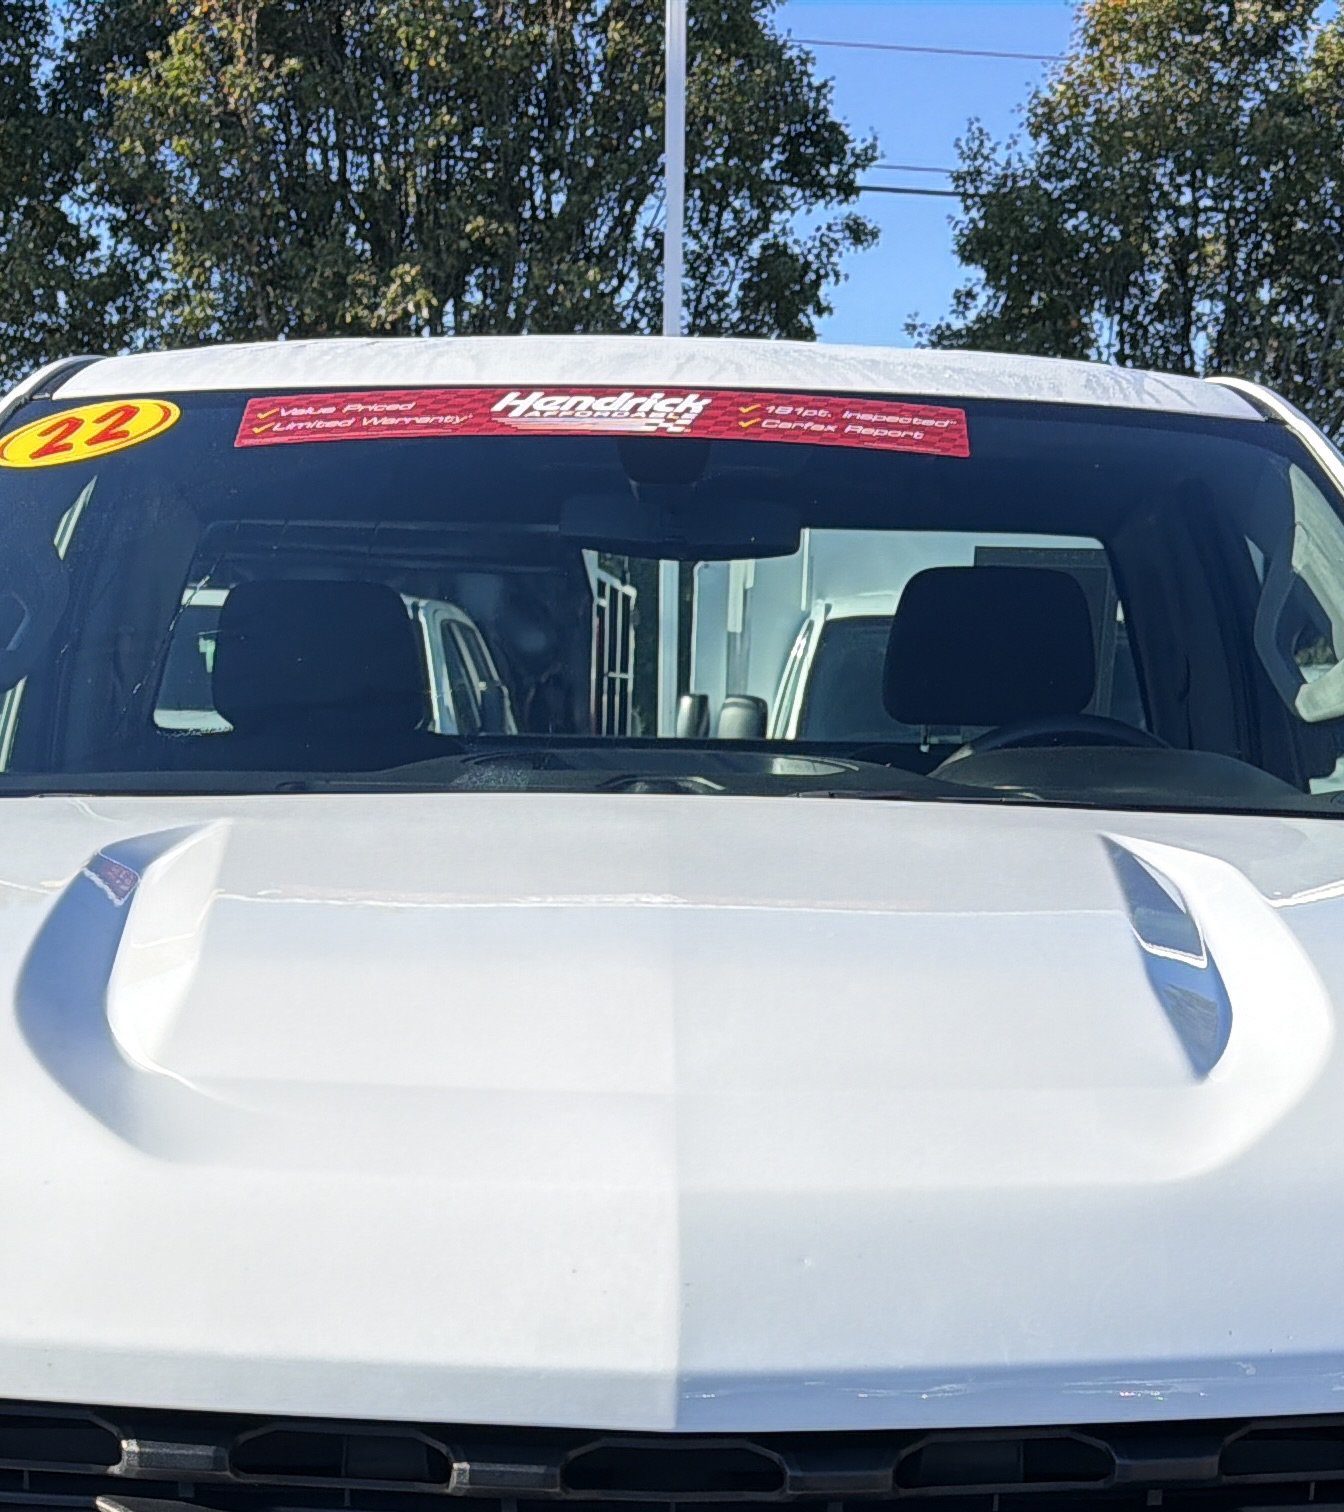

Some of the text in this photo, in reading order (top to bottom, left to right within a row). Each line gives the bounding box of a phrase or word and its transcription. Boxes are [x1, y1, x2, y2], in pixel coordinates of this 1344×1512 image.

[280, 401, 416, 418] Value Priced
[490, 391, 712, 418] Hendrick
[272, 418, 356, 432] Limited
[523, 411, 697, 420] AFFORDABLE
[29, 402, 142, 460] 22
[760, 418, 925, 440] Carfax Report
